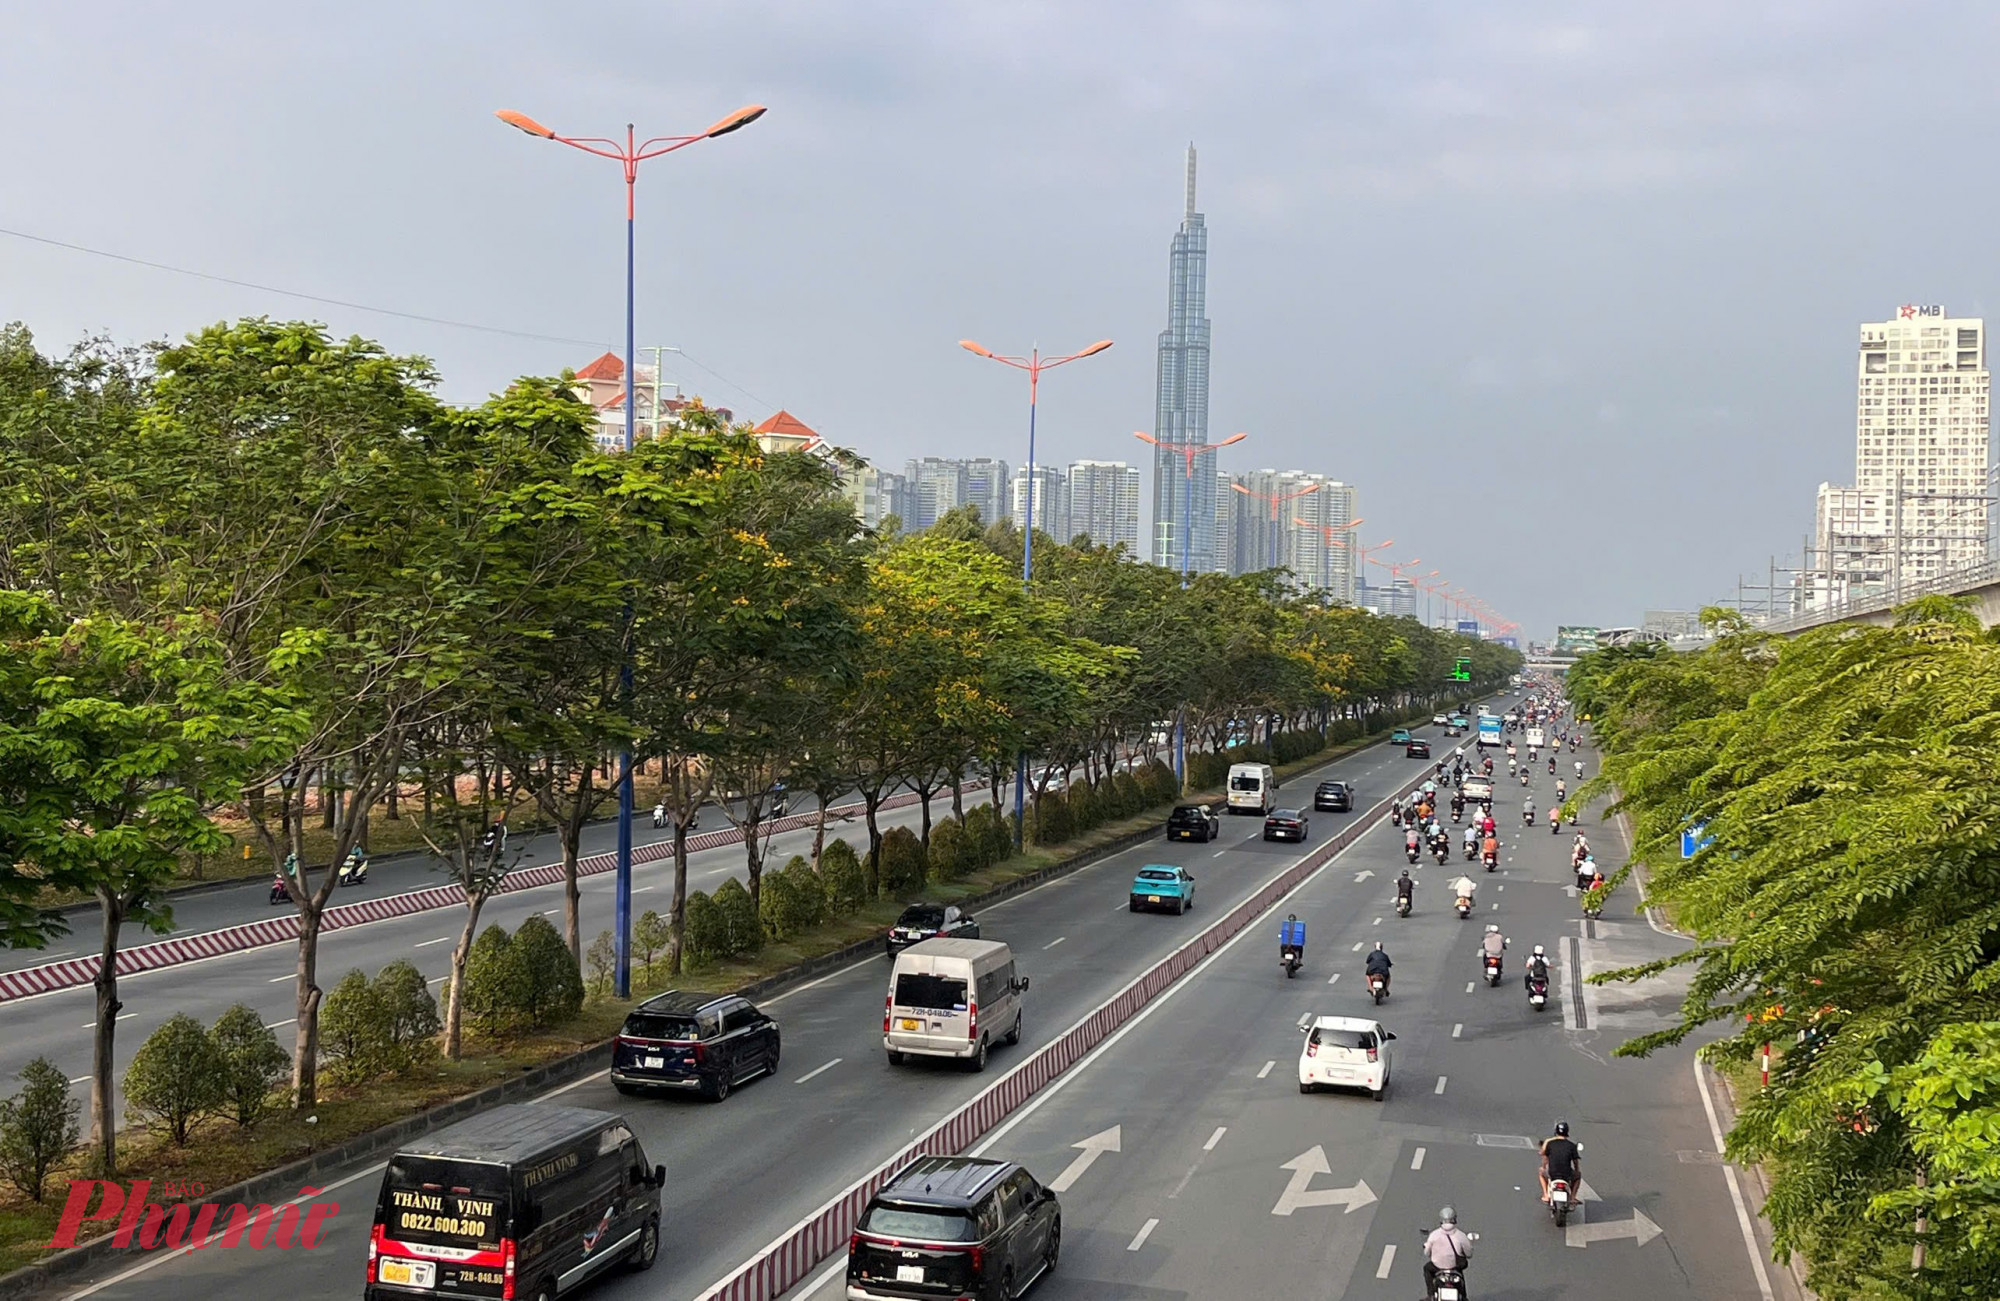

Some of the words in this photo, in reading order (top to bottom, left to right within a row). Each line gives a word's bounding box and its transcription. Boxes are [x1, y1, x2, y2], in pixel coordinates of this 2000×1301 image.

[1919, 305, 1940, 317] MB
[393, 1191, 442, 1211] THÀNH
[457, 1199, 493, 1217] VỊNH
[401, 1212, 485, 1237] 0822.600.300
